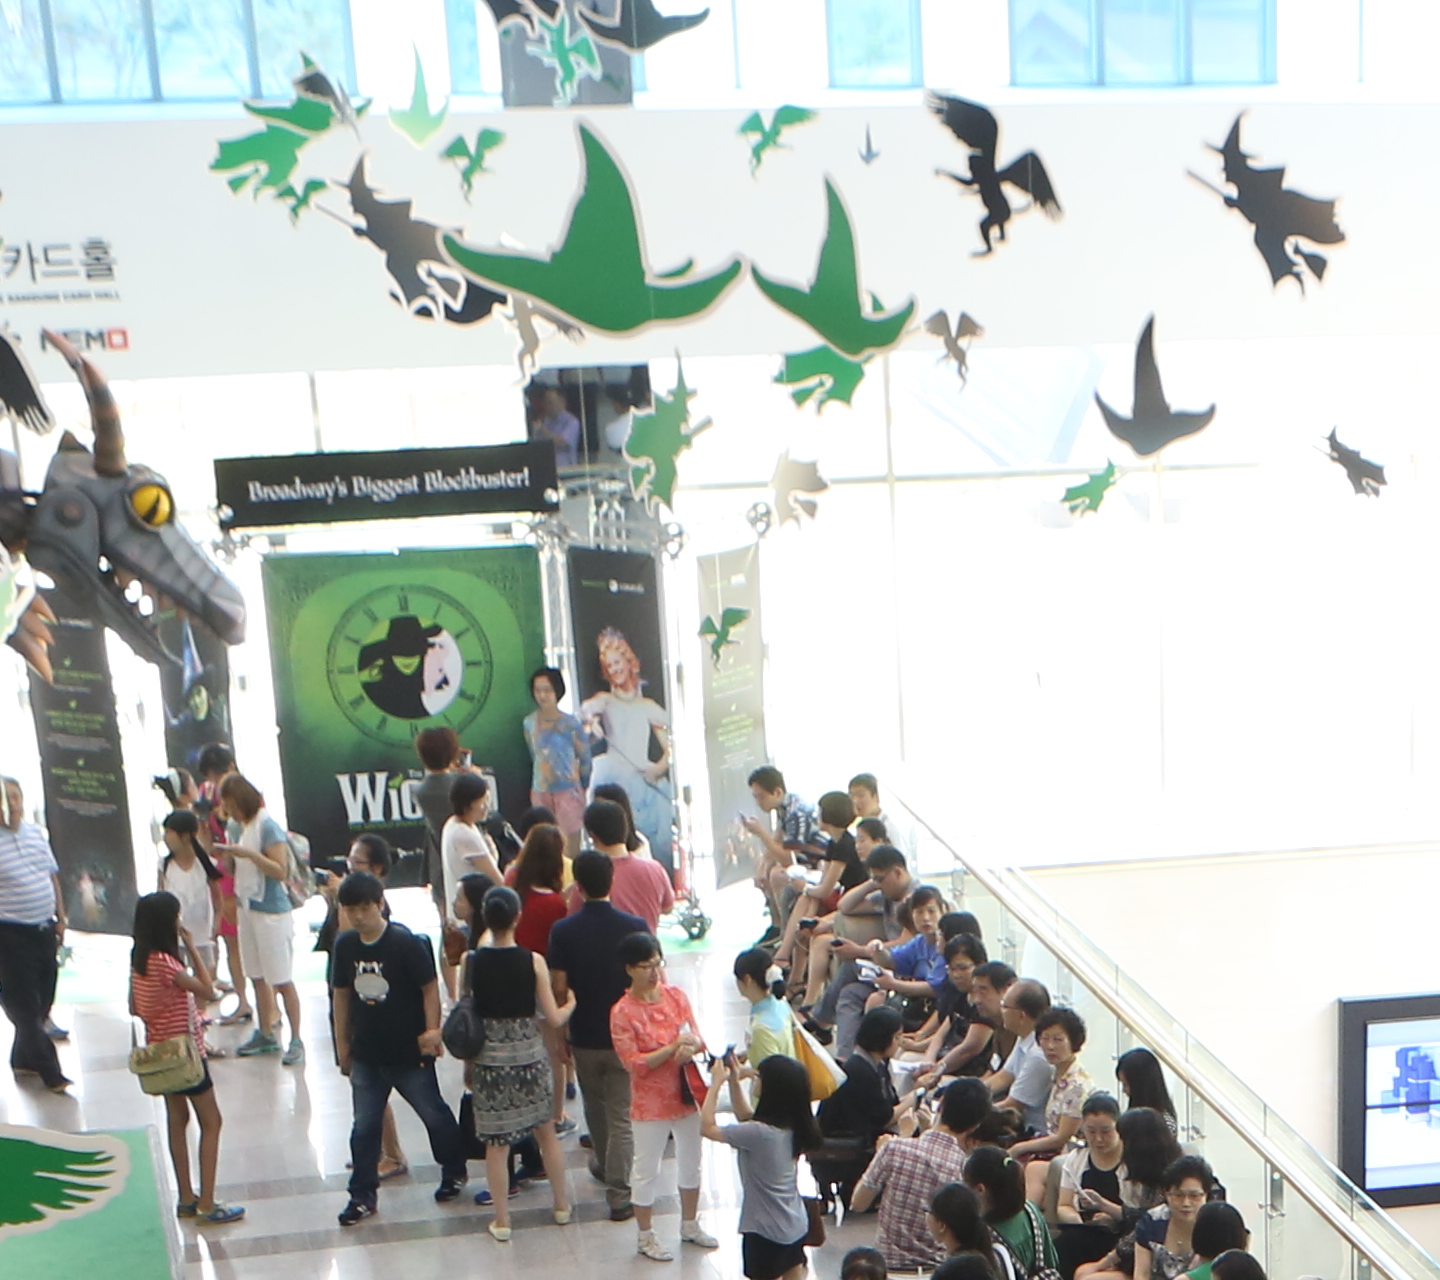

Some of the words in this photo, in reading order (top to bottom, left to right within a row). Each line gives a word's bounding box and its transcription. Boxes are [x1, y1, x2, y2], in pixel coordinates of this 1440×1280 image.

[248, 476, 348, 504] Broadway's
[353, 475, 419, 502] Biggest
[424, 466, 530, 493] Blockbuster!
